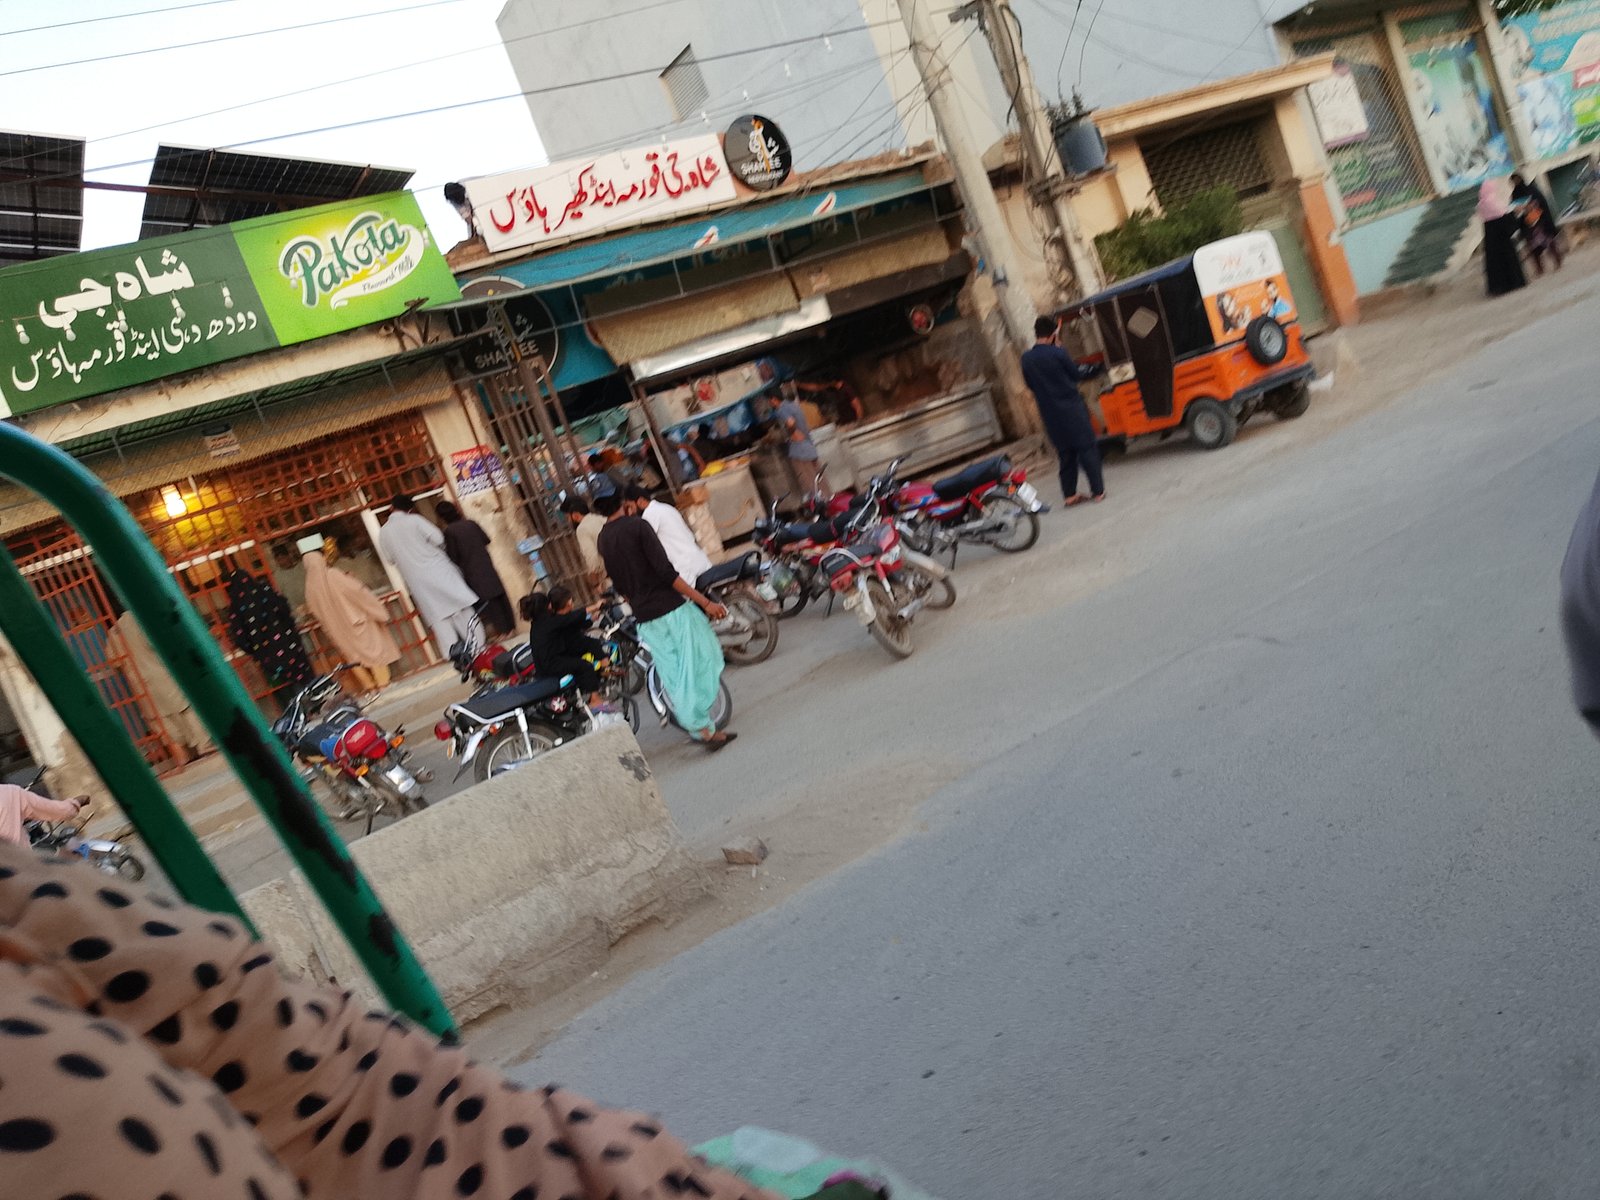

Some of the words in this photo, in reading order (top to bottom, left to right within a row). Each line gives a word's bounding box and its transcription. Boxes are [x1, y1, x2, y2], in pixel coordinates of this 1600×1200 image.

[590, 176, 618, 207] اینڈ
[615, 153, 663, 204] قورمہ
[661, 151, 690, 199] جی
[687, 156, 720, 191] شاہ
[490, 185, 551, 235] ہاؤس
[115, 248, 195, 301] شاہ
[38, 278, 112, 329] جی
[206, 310, 257, 340] دودھ
[13, 341, 83, 392] ہاؤس
[80, 321, 126, 371] قورمہ
[122, 327, 160, 361] اینڈ
